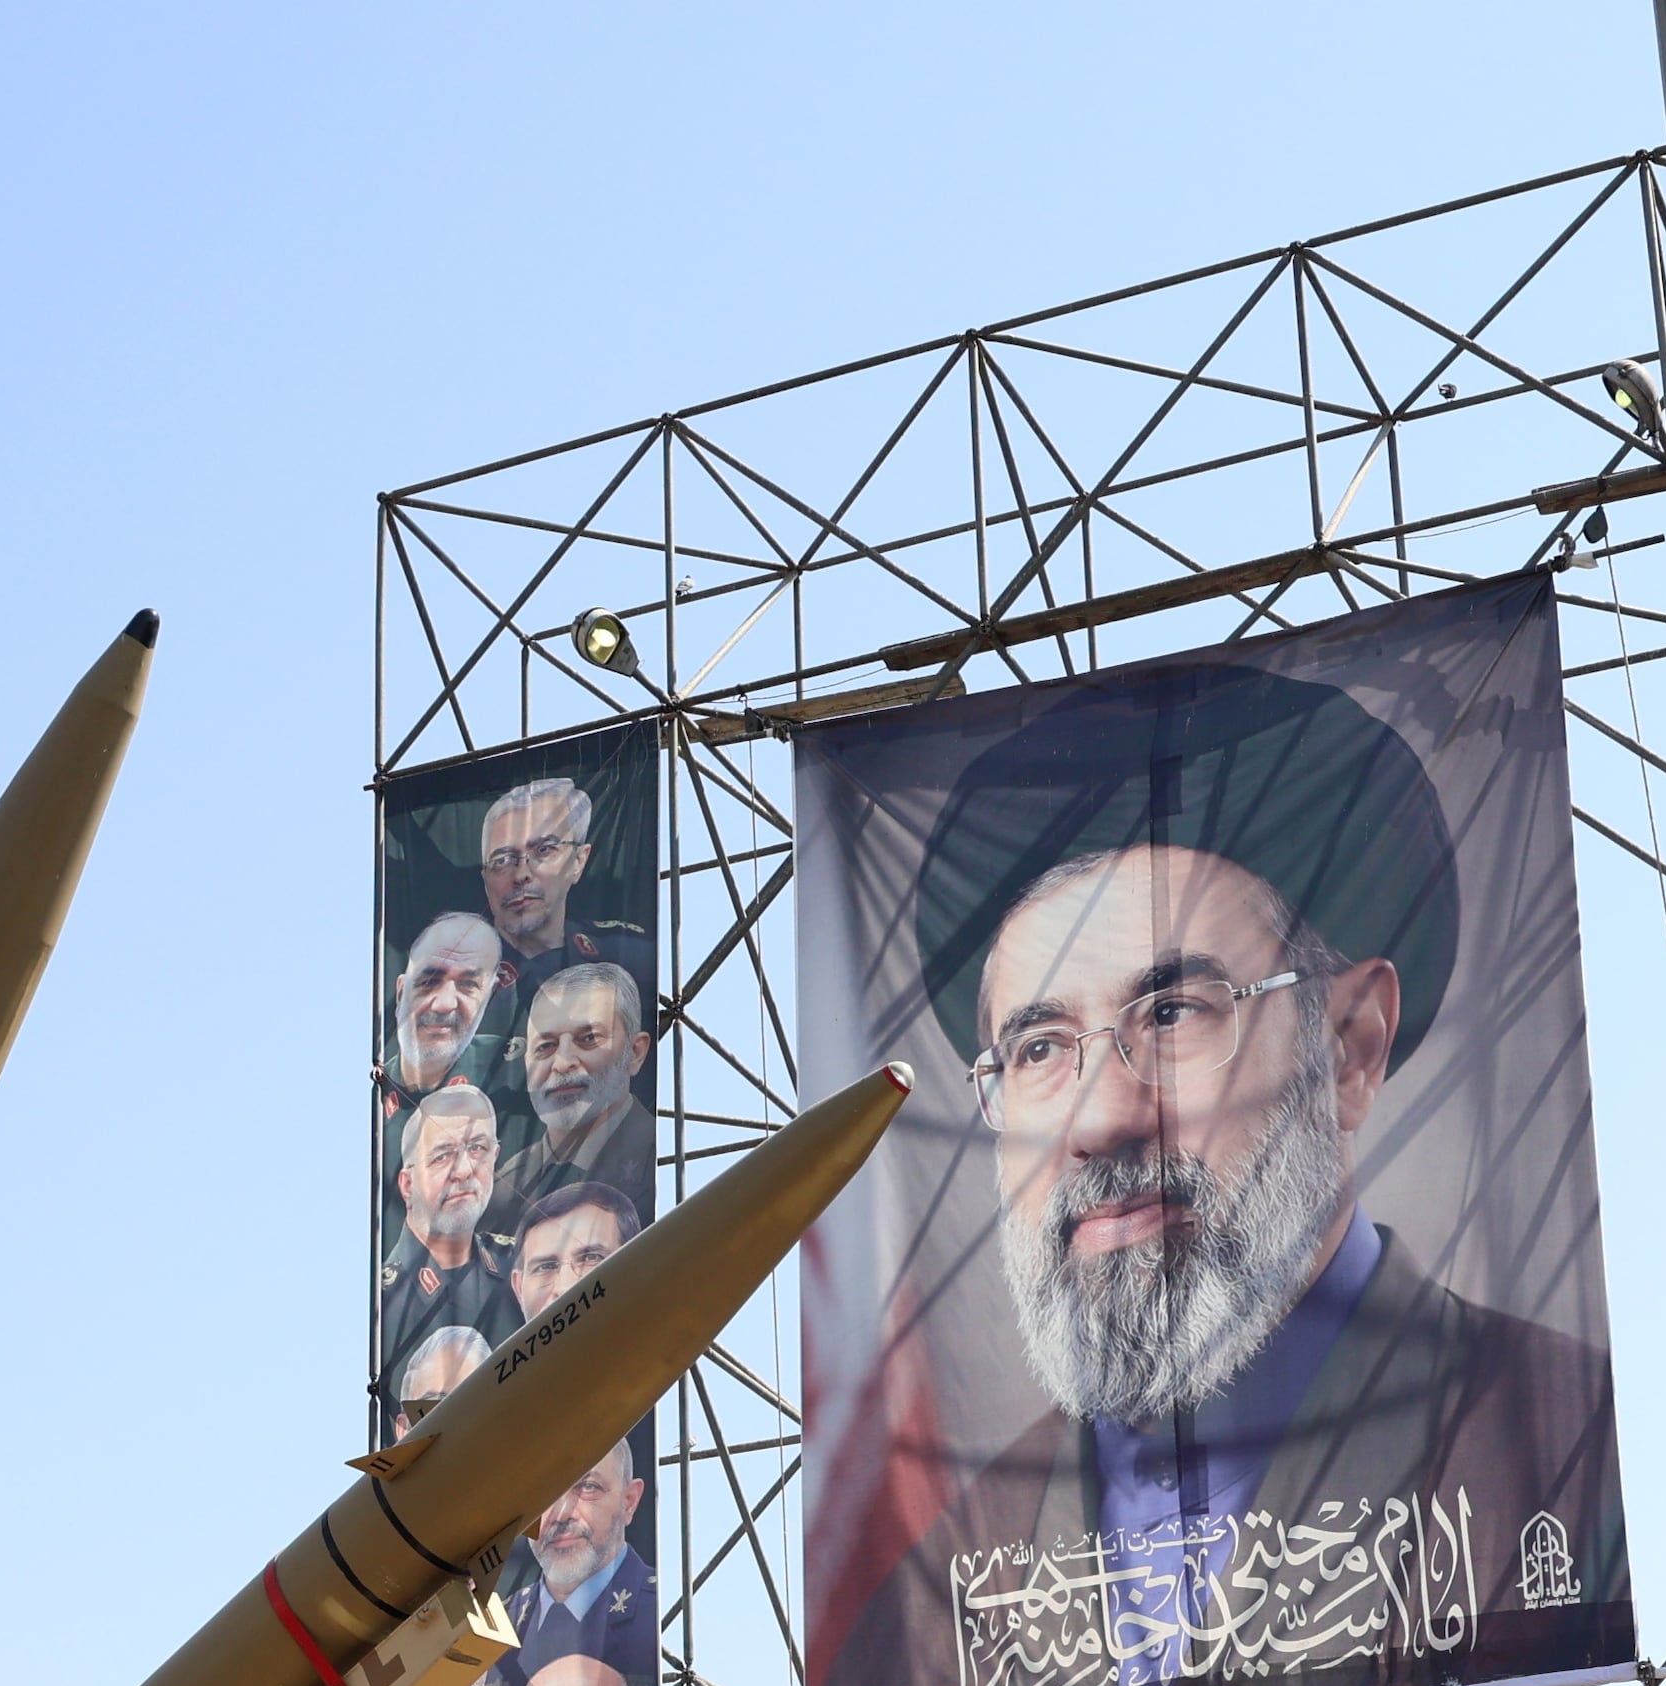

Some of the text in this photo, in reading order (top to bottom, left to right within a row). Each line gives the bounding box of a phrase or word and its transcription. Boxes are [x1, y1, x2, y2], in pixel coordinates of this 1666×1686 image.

[494, 1279, 606, 1384] ZA795214
[369, 1457, 395, 1472] II
[478, 1544, 504, 1576] III
